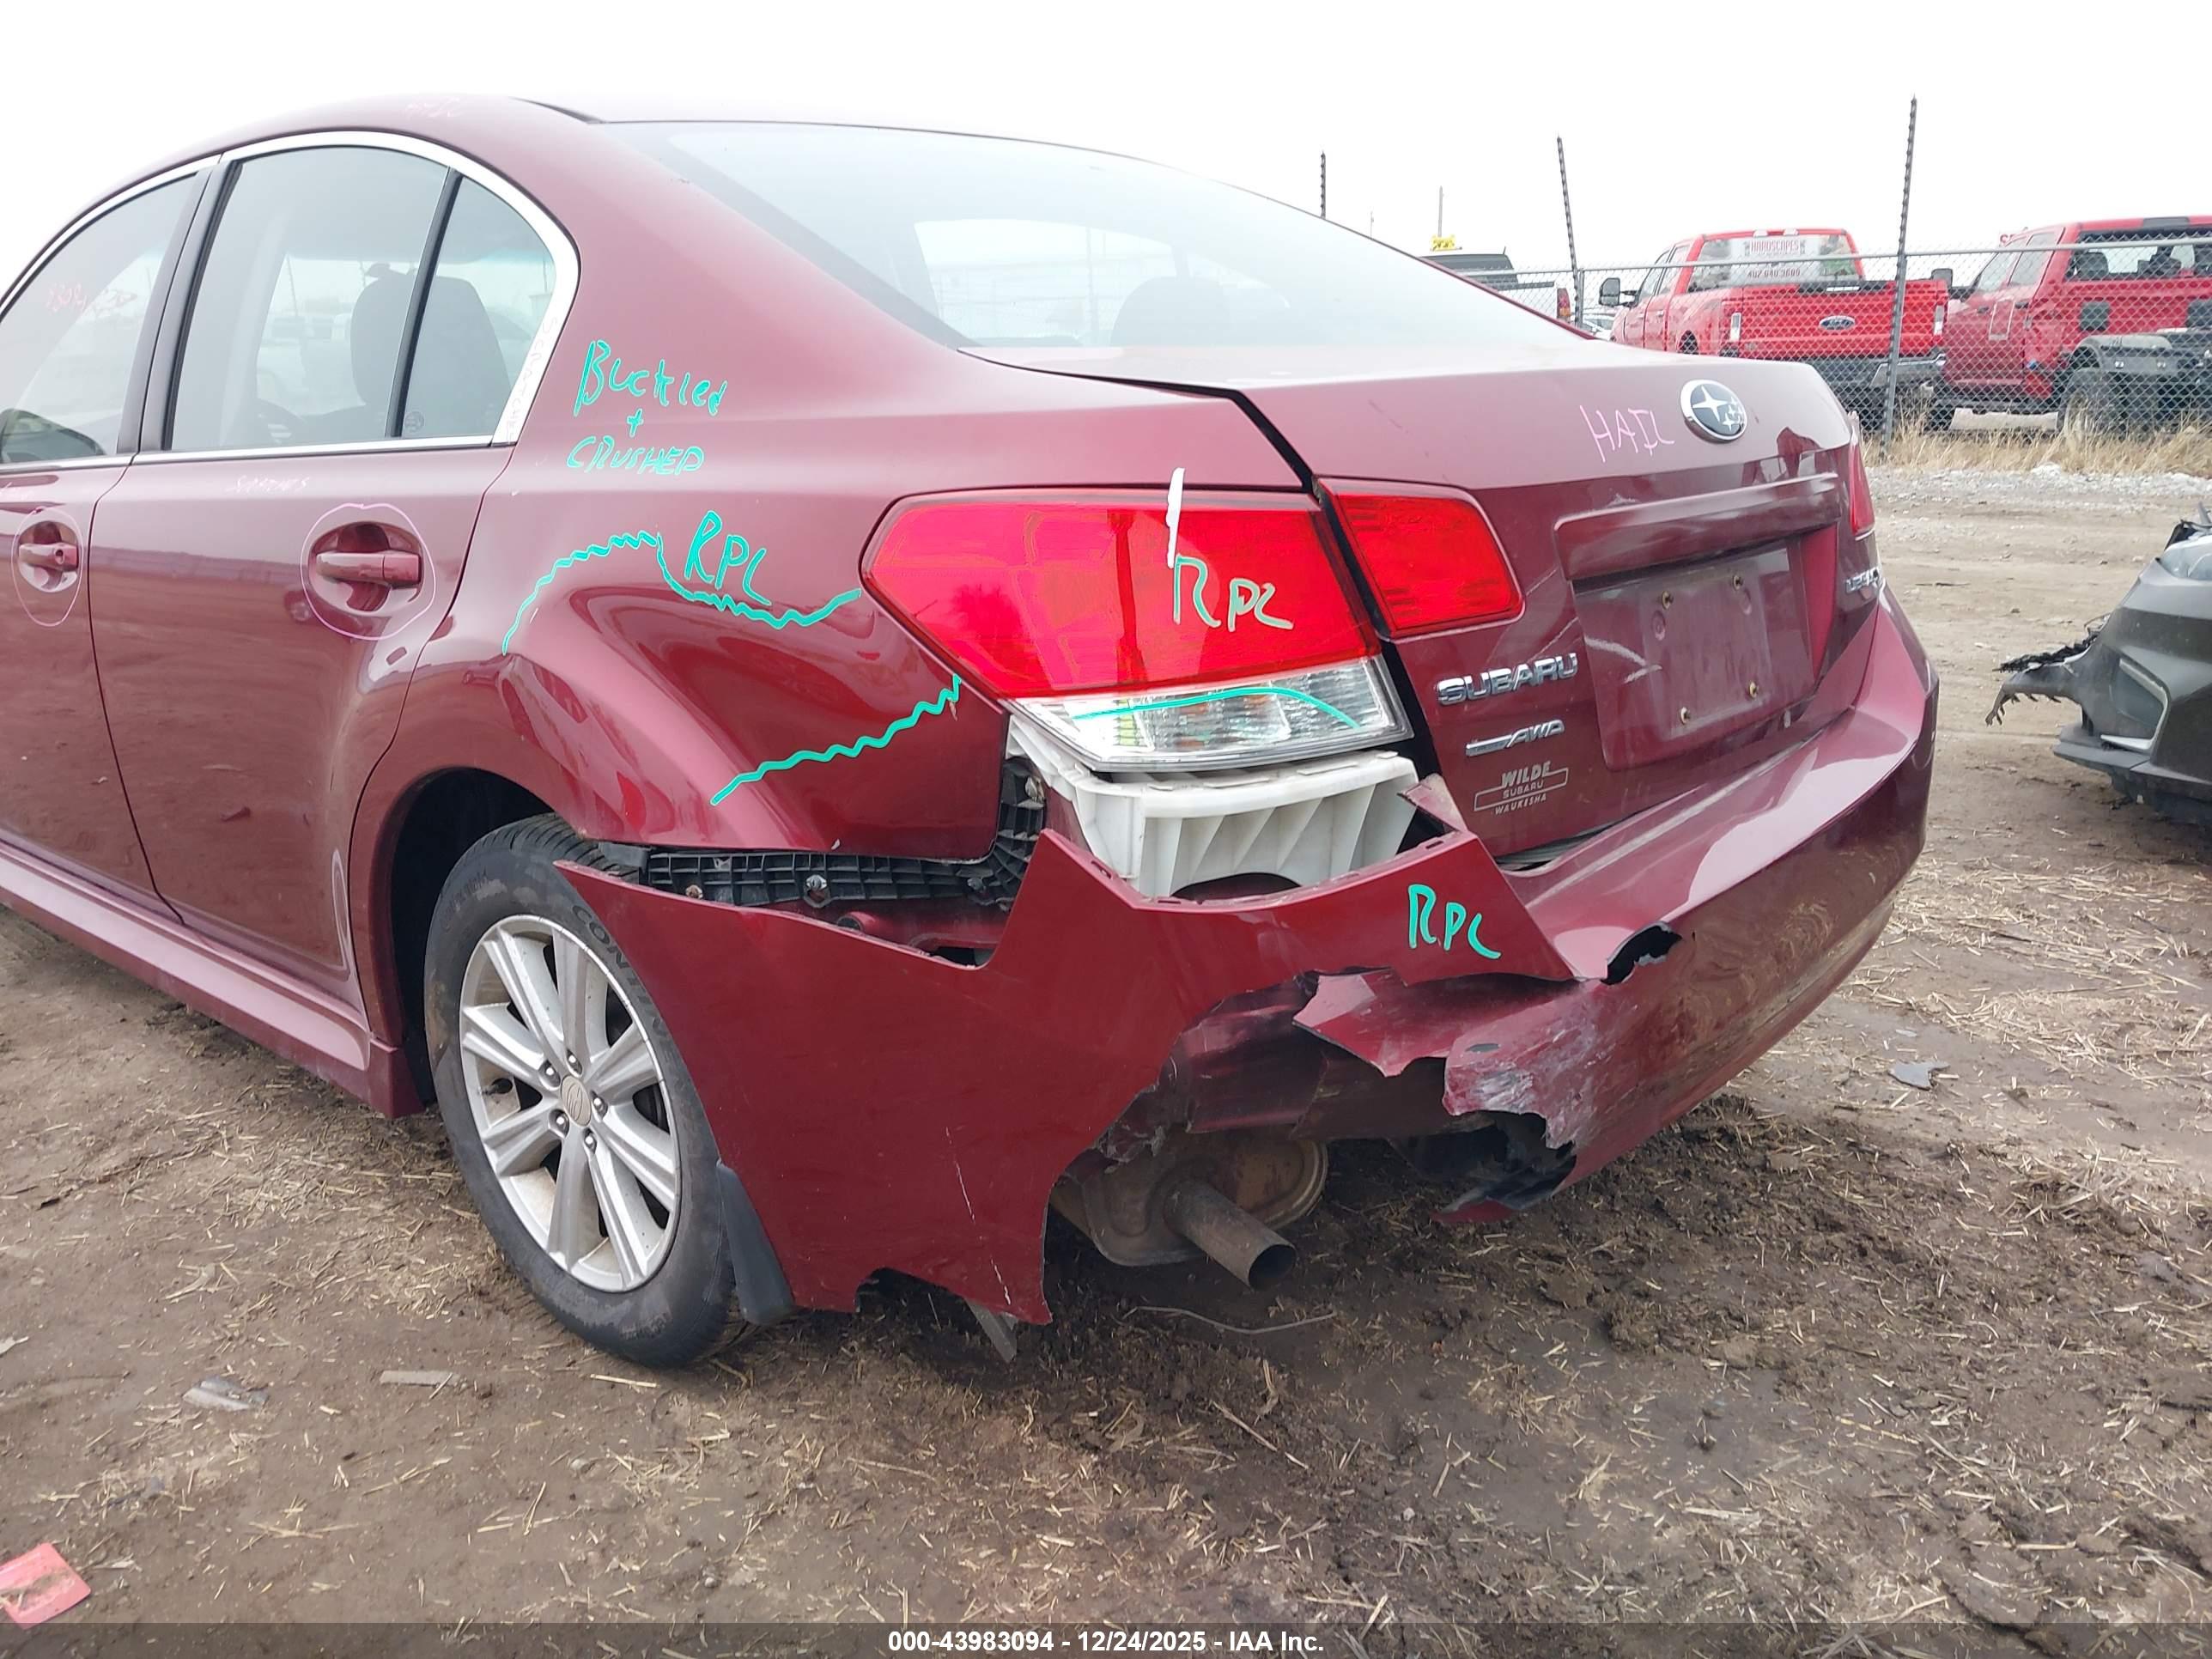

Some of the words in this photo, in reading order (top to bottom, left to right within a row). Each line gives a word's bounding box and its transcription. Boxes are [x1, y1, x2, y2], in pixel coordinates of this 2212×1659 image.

[1579, 404, 1675, 463] HAIL
[567, 434, 705, 475] CRUSHED
[684, 510, 772, 605] RPC
[1437, 653, 1578, 706] SUBARU
[1507, 719, 1565, 748] AWD
[1501, 761, 1551, 788] WILDE
[1503, 780, 1545, 799] SUBARU
